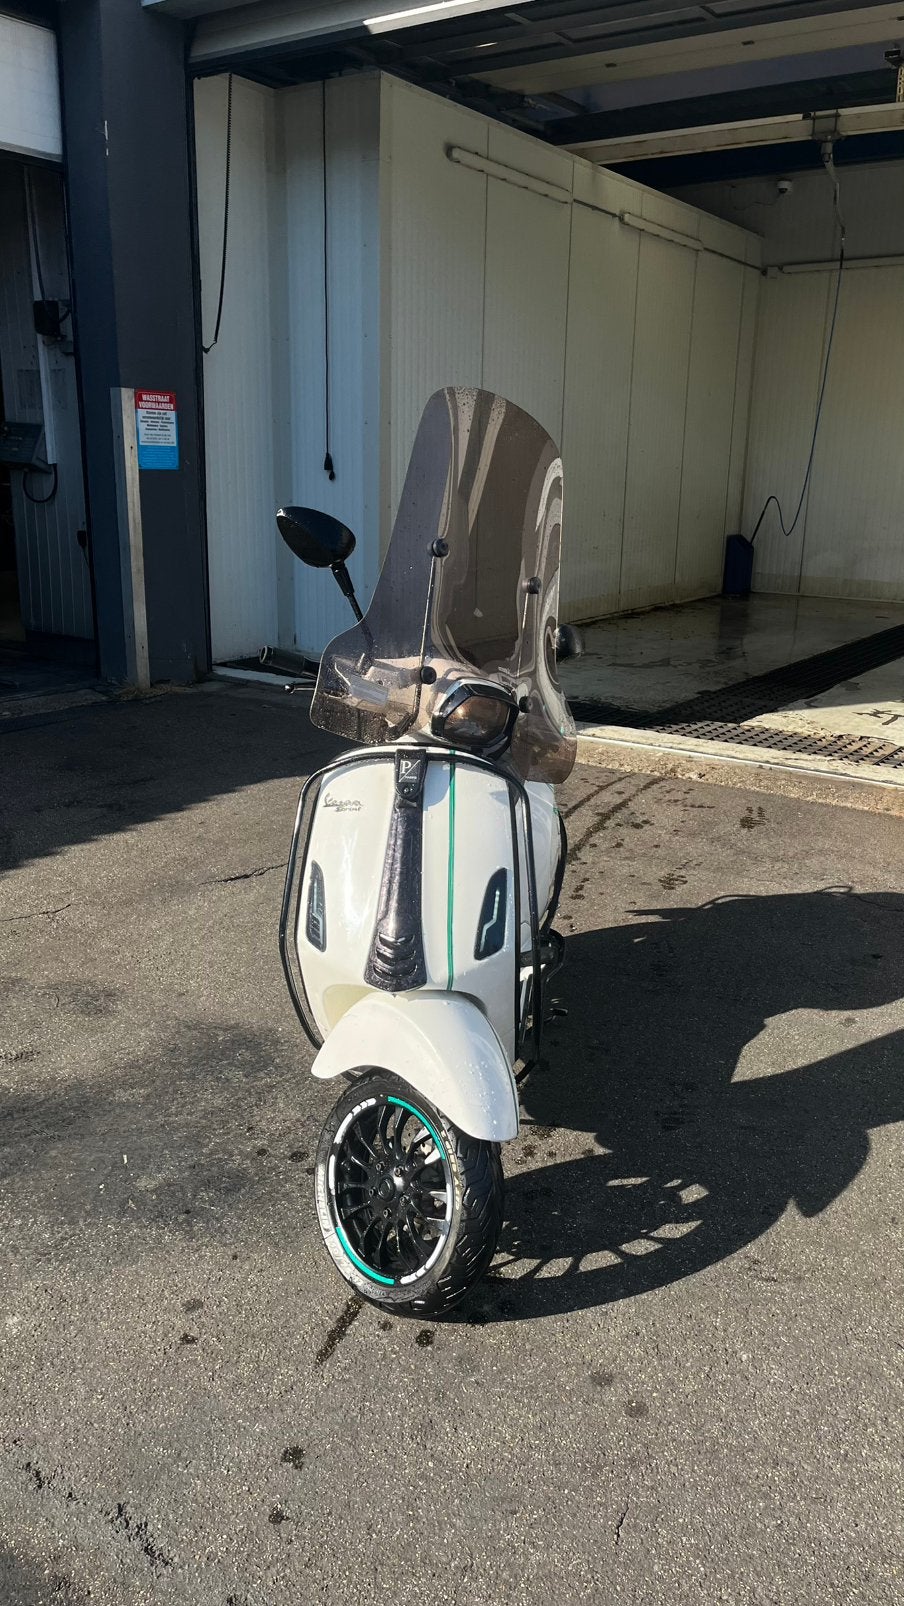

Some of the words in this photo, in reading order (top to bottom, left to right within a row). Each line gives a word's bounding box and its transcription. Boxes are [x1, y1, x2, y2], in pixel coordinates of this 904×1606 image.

[141, 394, 170, 402] WASSTRAAT
[138, 401, 174, 411] VOORWAARDEN
[323, 792, 363, 807] Vespa
